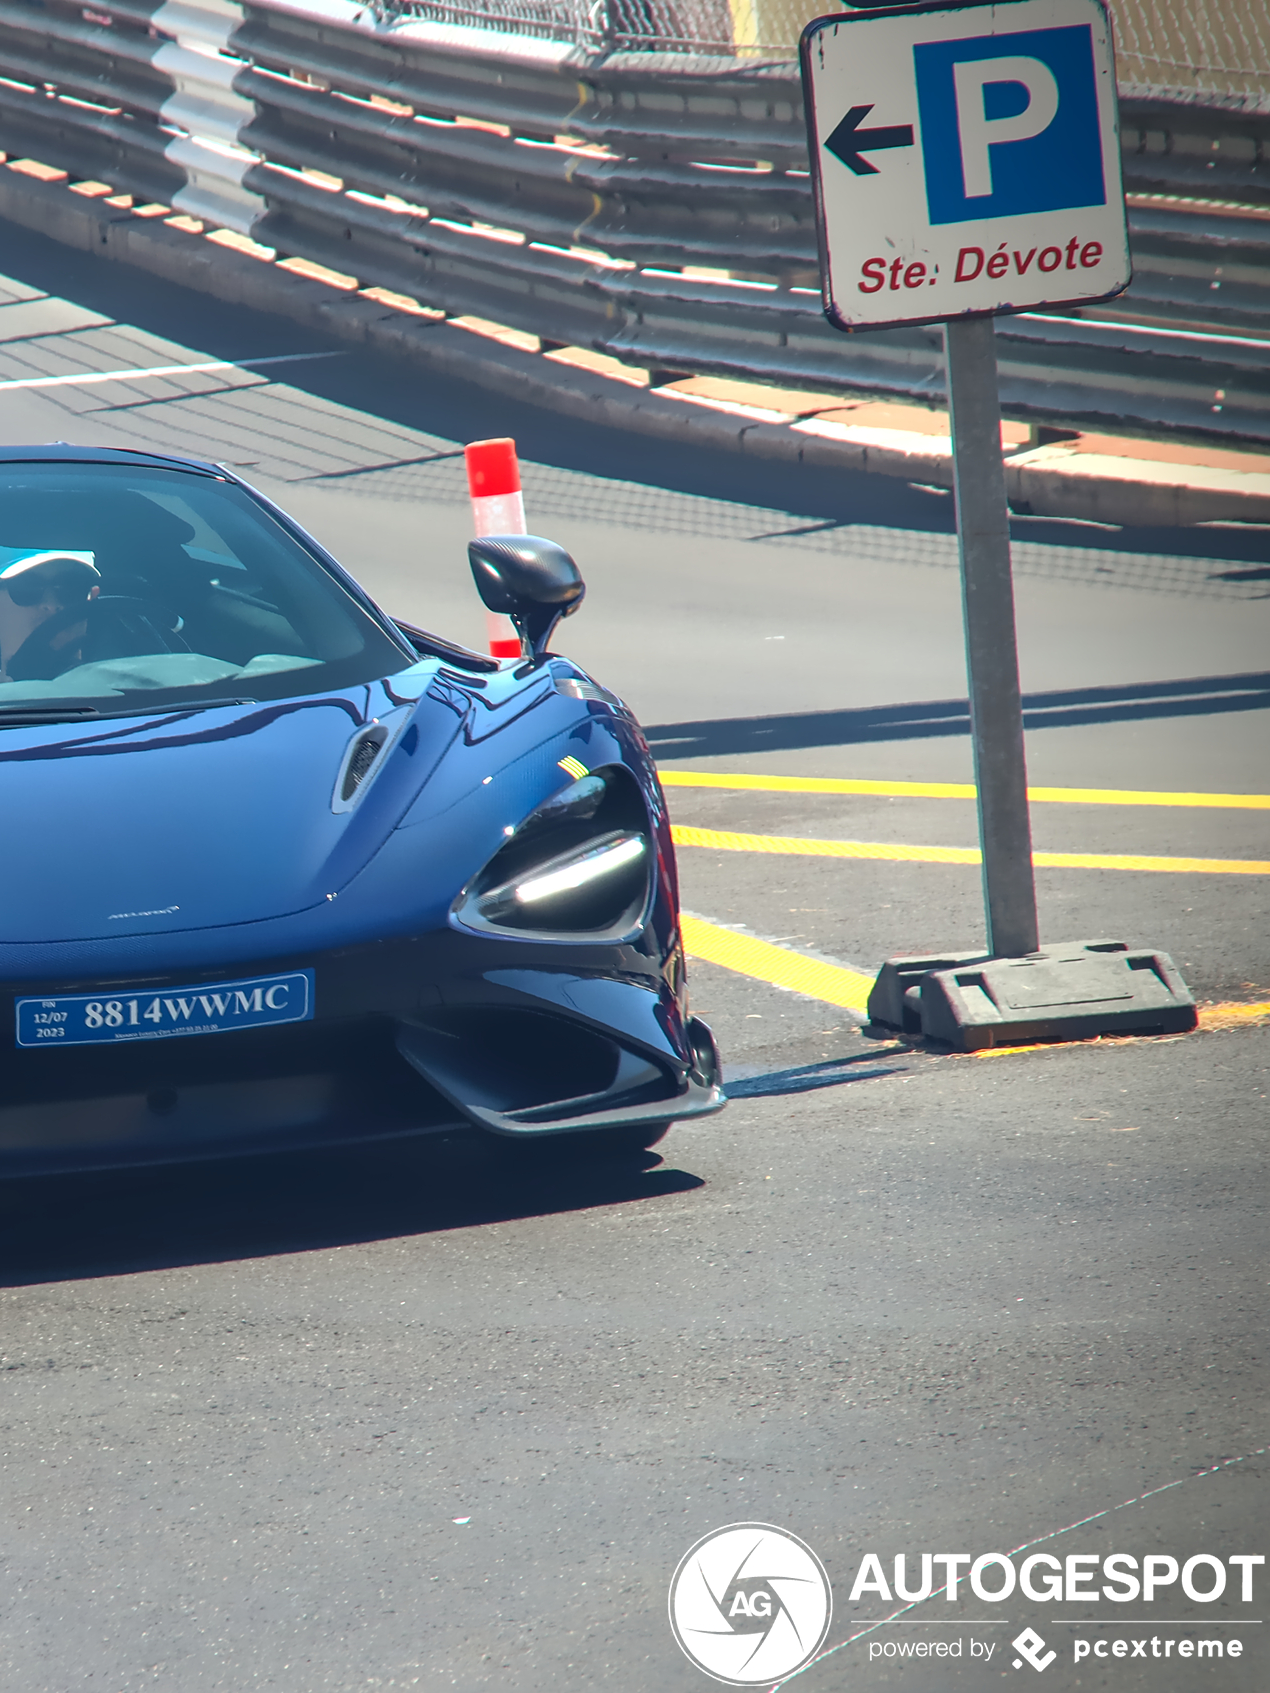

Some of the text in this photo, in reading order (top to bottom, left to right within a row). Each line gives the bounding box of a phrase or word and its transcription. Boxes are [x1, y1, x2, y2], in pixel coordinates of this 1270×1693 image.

[953, 55, 1059, 199] P
[954, 236, 1103, 283] Dévote
[33, 1011, 68, 1024] 12/07
[84, 983, 289, 1028] 8814WWMC
[36, 1027, 65, 1038] 2023
